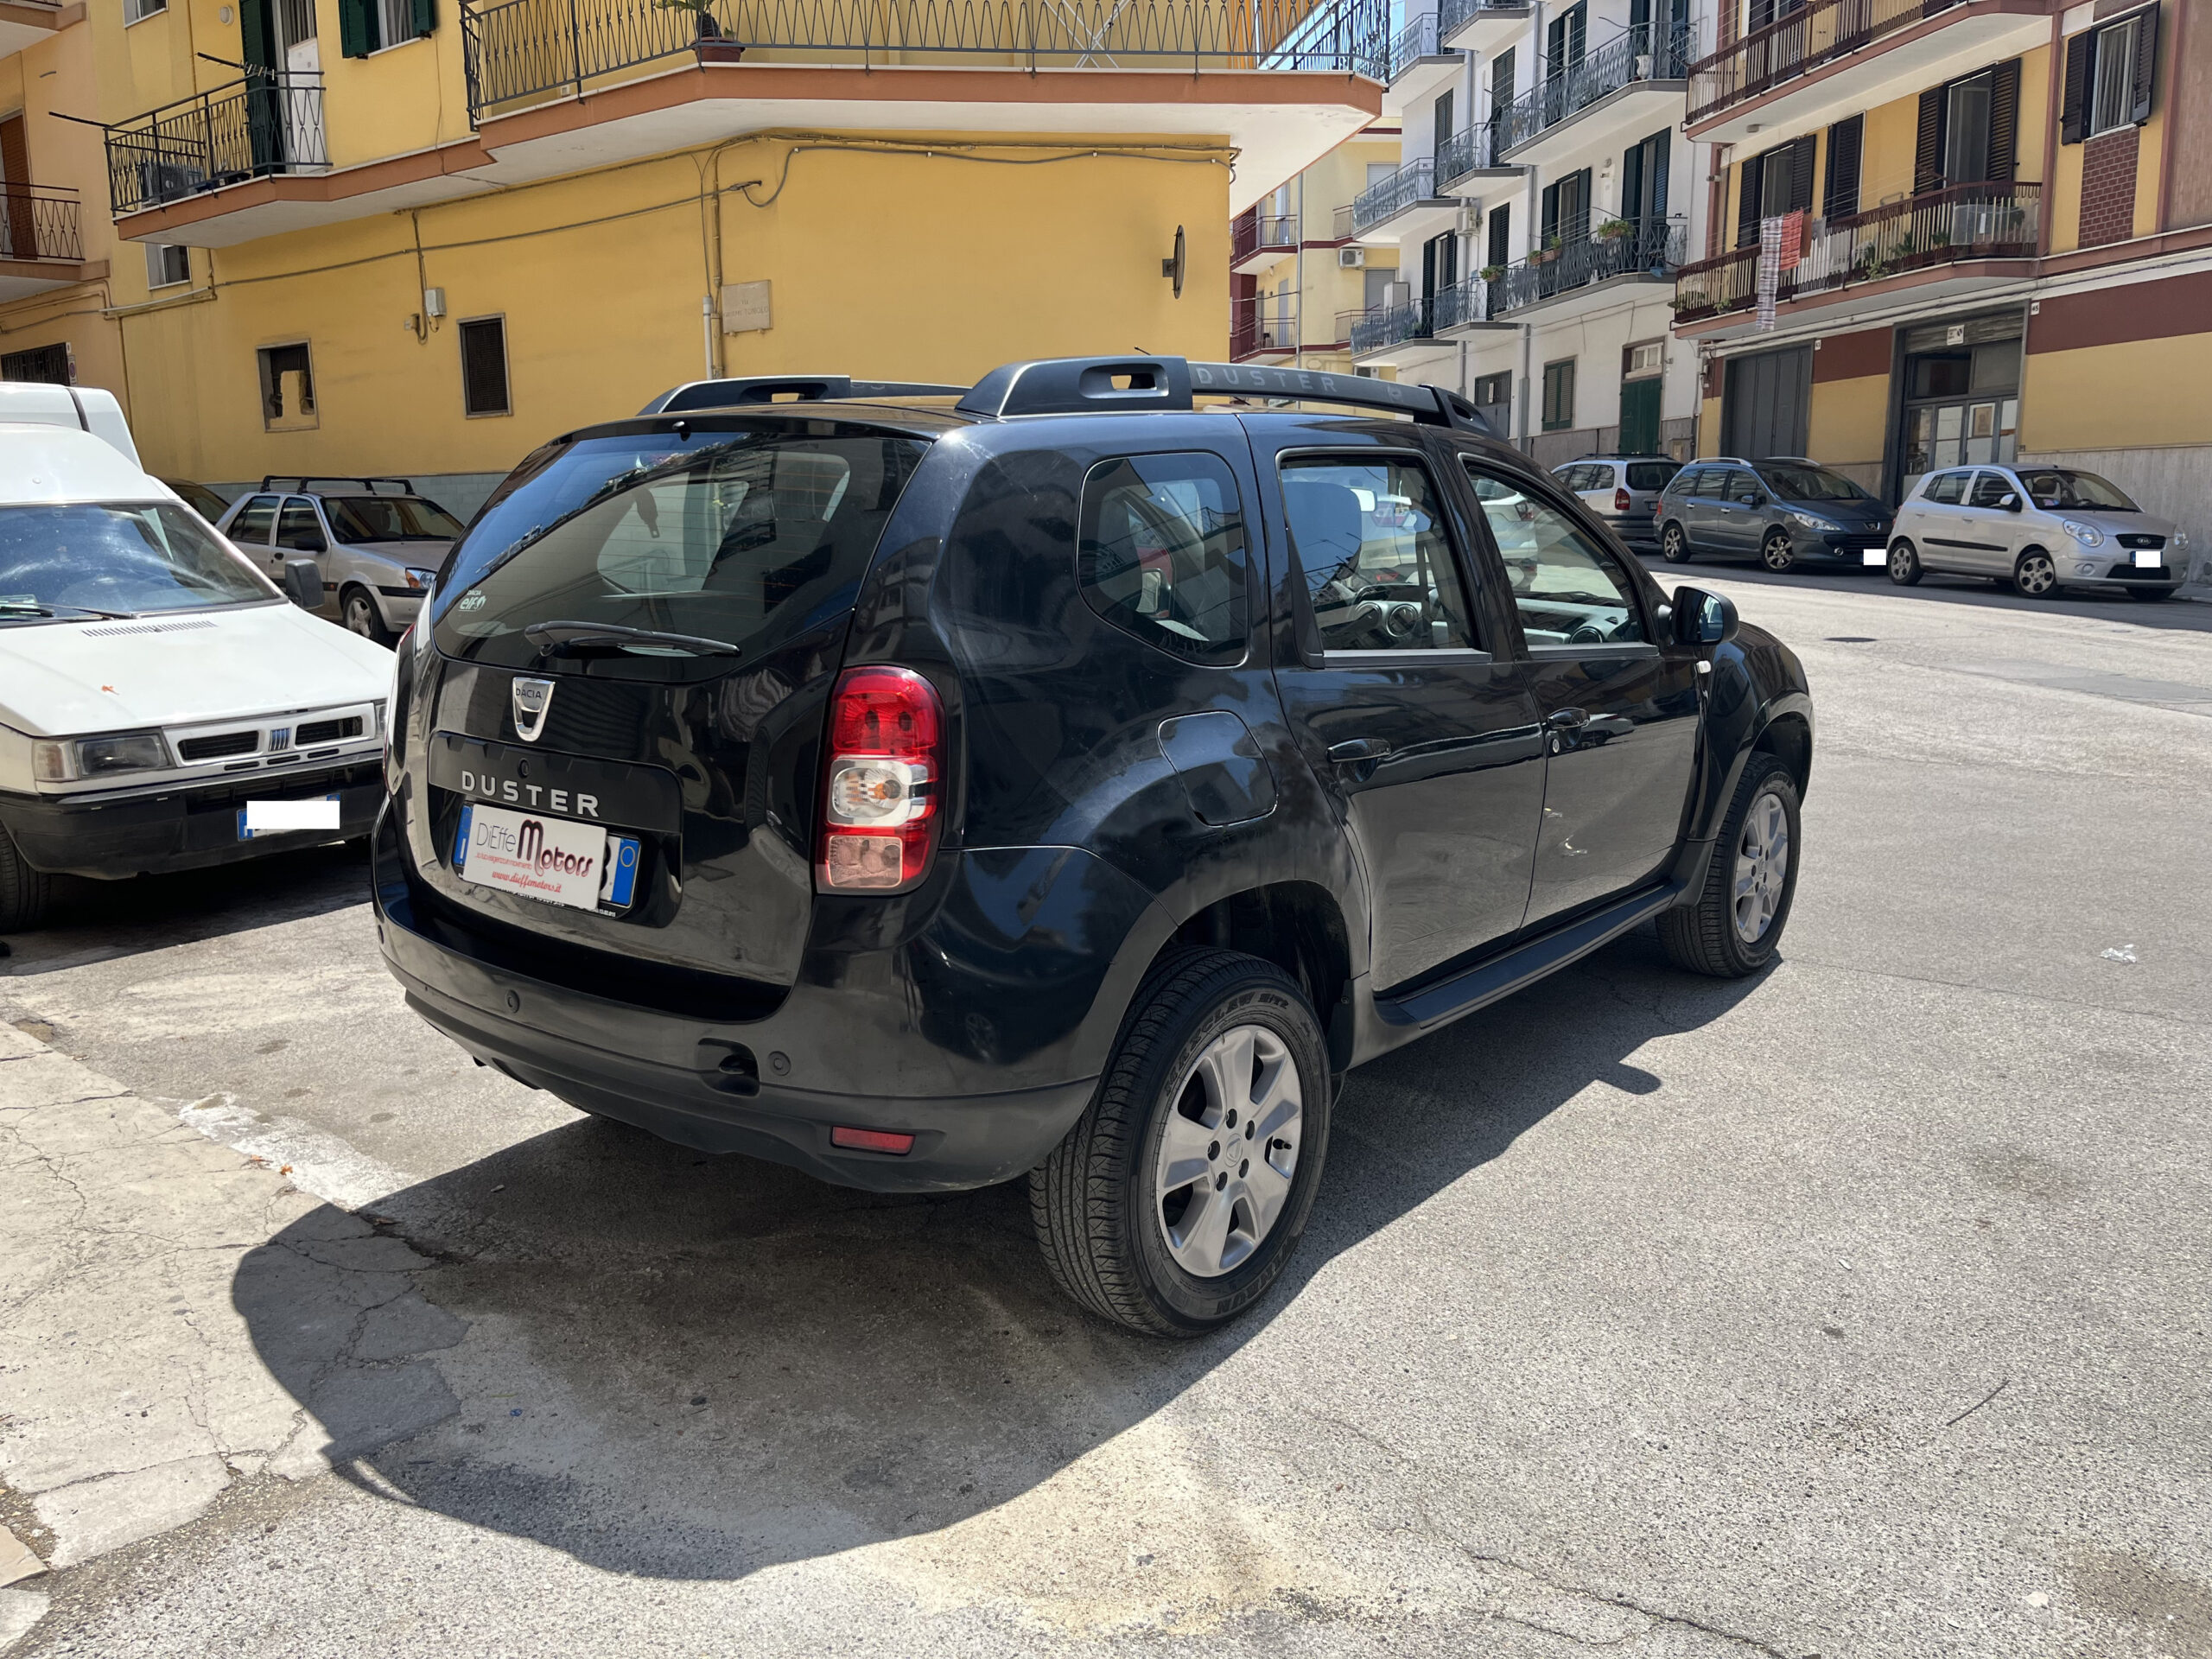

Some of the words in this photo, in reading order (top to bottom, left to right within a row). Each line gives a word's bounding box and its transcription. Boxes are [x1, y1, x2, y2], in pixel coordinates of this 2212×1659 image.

[1195, 367, 1338, 392] DUSTER
[516, 688, 543, 699] DACIA
[461, 770, 600, 817] DUSTER
[476, 822, 517, 852] DiEffe
[517, 818, 594, 877] Motors
[492, 870, 563, 893] www.dieffemotors.it
